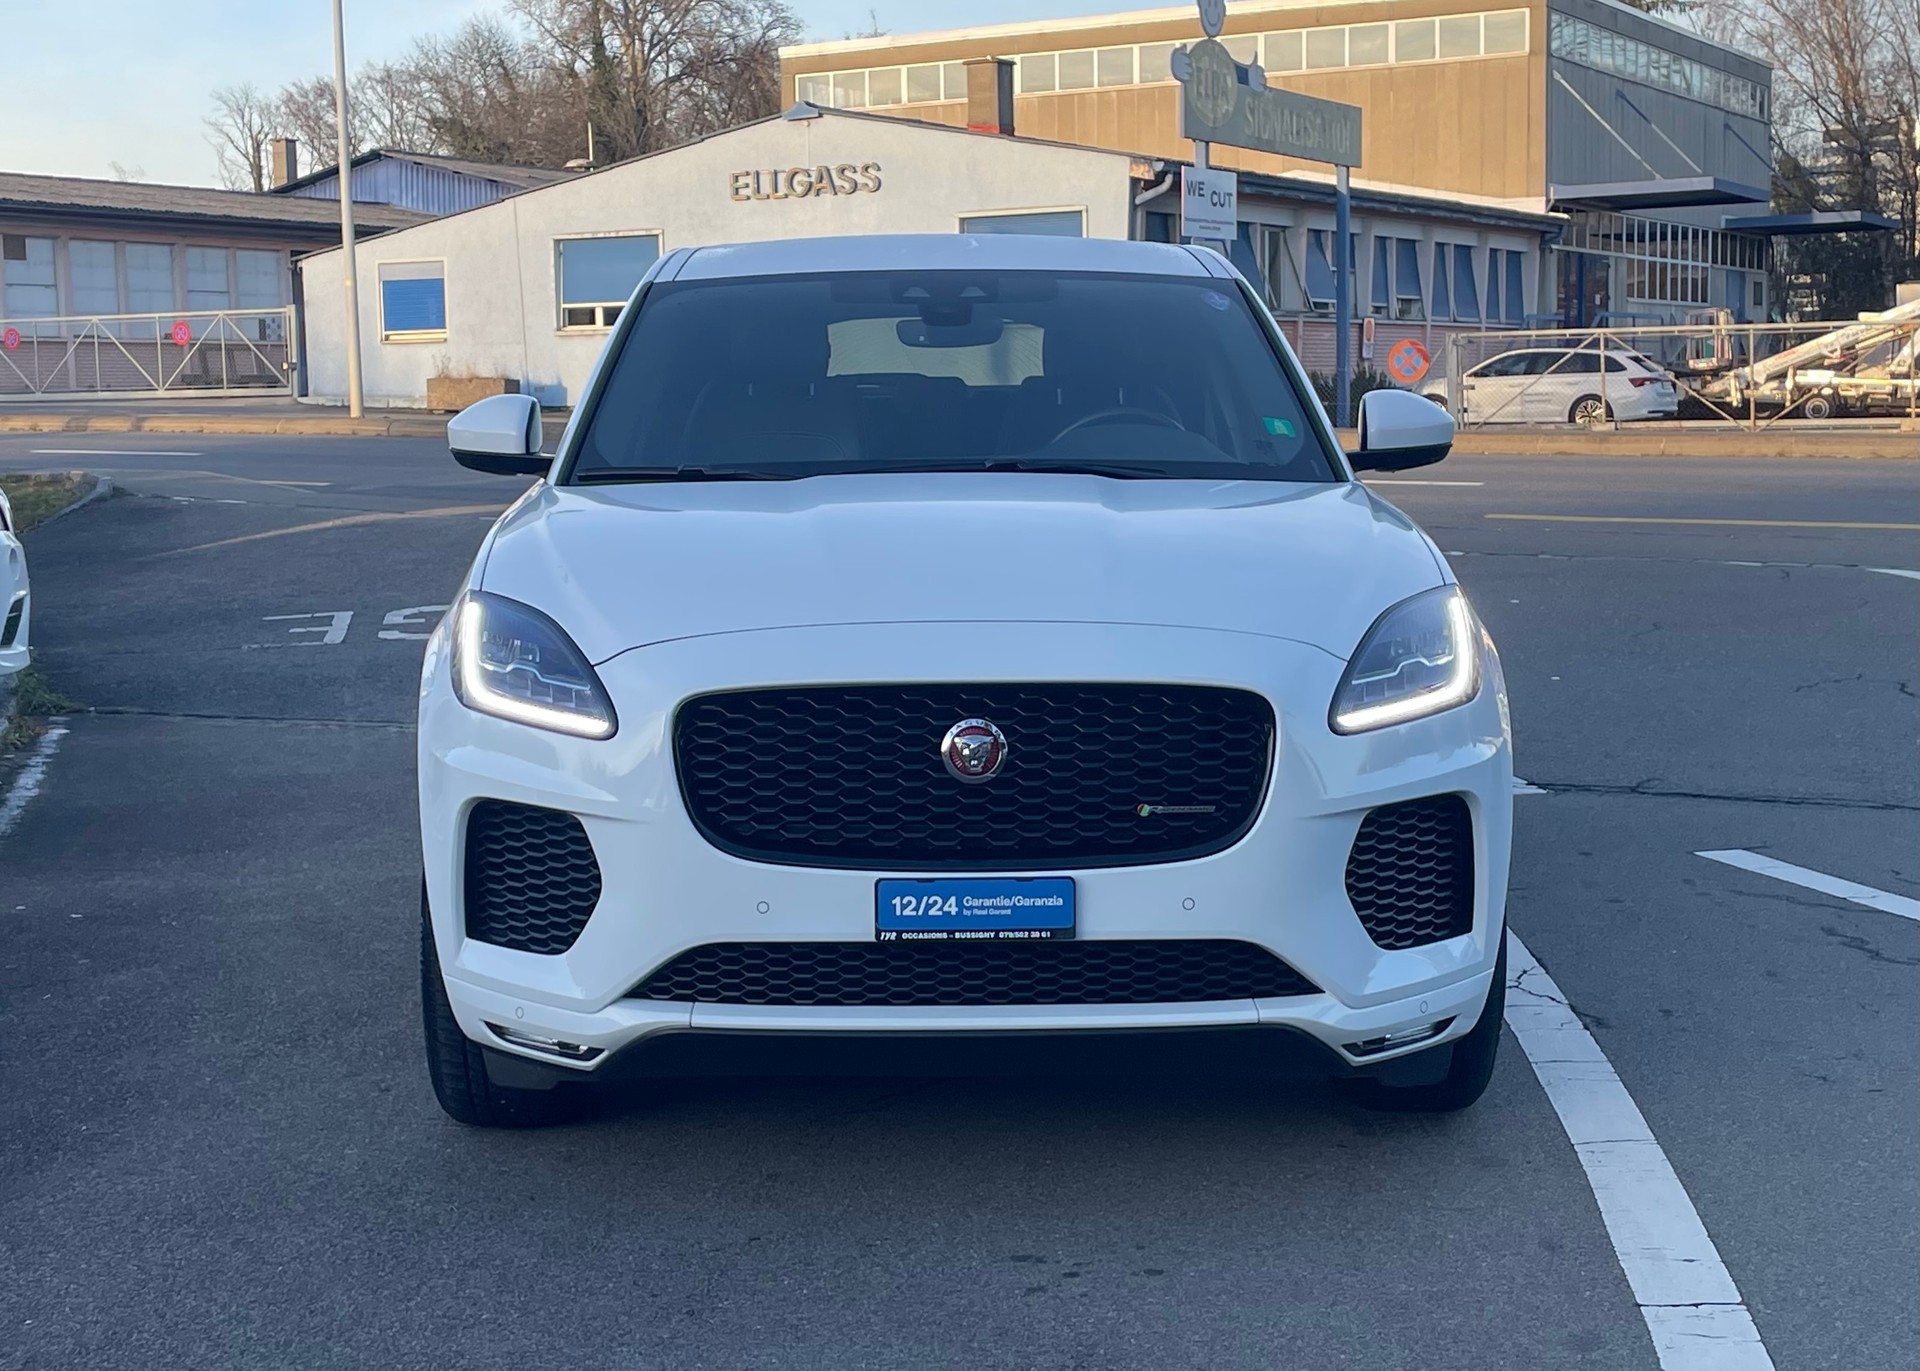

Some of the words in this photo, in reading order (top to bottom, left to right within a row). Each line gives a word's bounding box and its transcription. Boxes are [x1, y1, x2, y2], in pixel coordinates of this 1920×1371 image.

[729, 162, 882, 201] ELLGASS
[1186, 179, 1205, 197] WE
[1210, 190, 1233, 208] CUT
[949, 719, 1002, 739] JAGUAR
[891, 895, 959, 916] 12/24
[963, 895, 1064, 907] Garantie/Garanzia
[954, 931, 995, 939] BUSSIGNY
